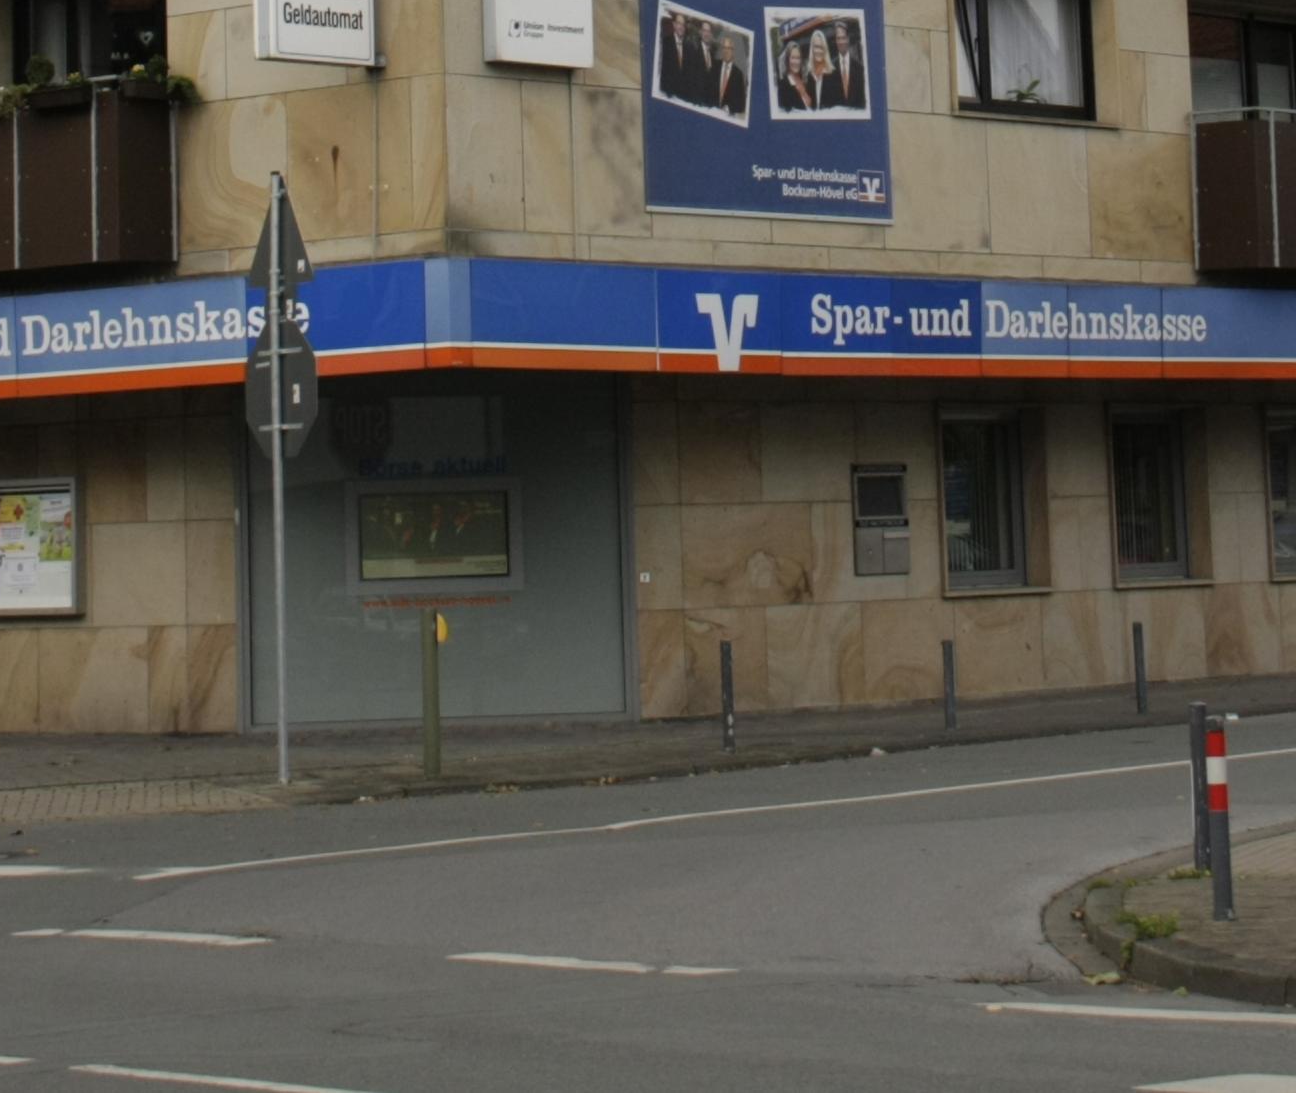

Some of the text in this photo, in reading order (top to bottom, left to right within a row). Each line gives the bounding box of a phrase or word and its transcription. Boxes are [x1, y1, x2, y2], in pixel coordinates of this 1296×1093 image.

[283, 2, 364, 31] Geldautomat
[777, 167, 796, 180] und
[797, 168, 857, 183] Darlehnskasse
[782, 184, 844, 199] Bockum-Hövel
[21, 300, 310, 356] Darlehnskase
[911, 299, 972, 337] und
[985, 300, 1207, 343] Darlehnskasse
[432, 455, 508, 475] aktuell
